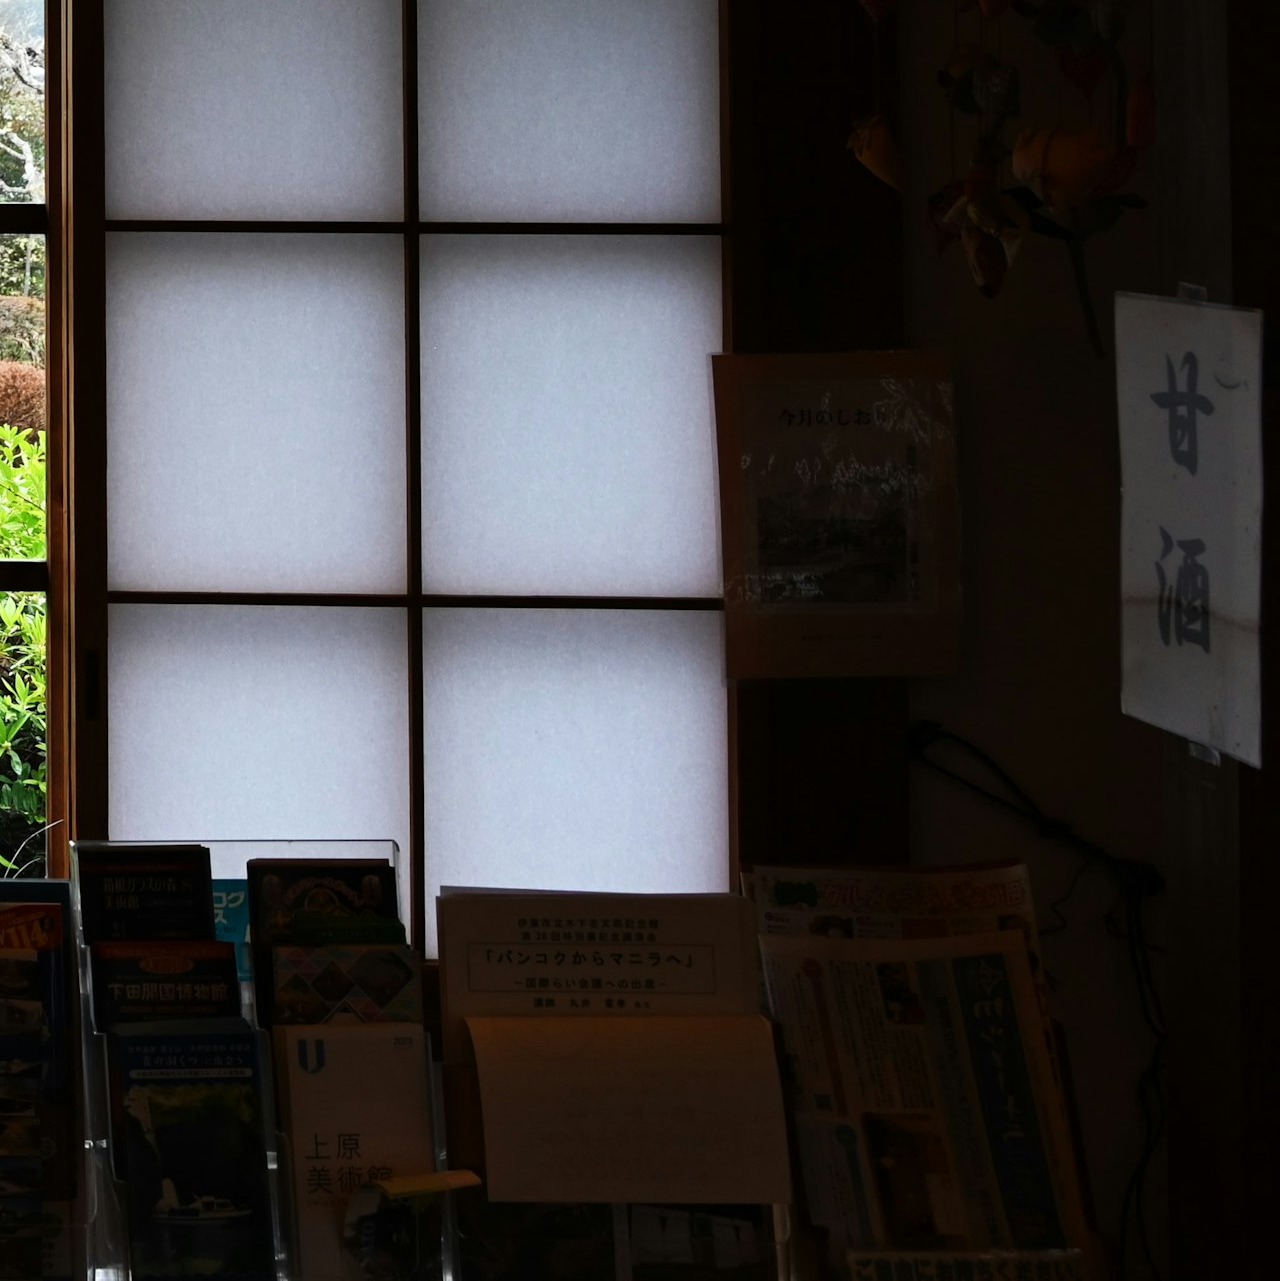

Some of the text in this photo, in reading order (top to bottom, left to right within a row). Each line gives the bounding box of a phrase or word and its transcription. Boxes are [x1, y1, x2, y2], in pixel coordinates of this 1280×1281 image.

[1150, 351, 1215, 654] 甘酒
[485, 949, 695, 969] 「バンコクからマニラへ」
[304, 1133, 362, 1160] 上原
